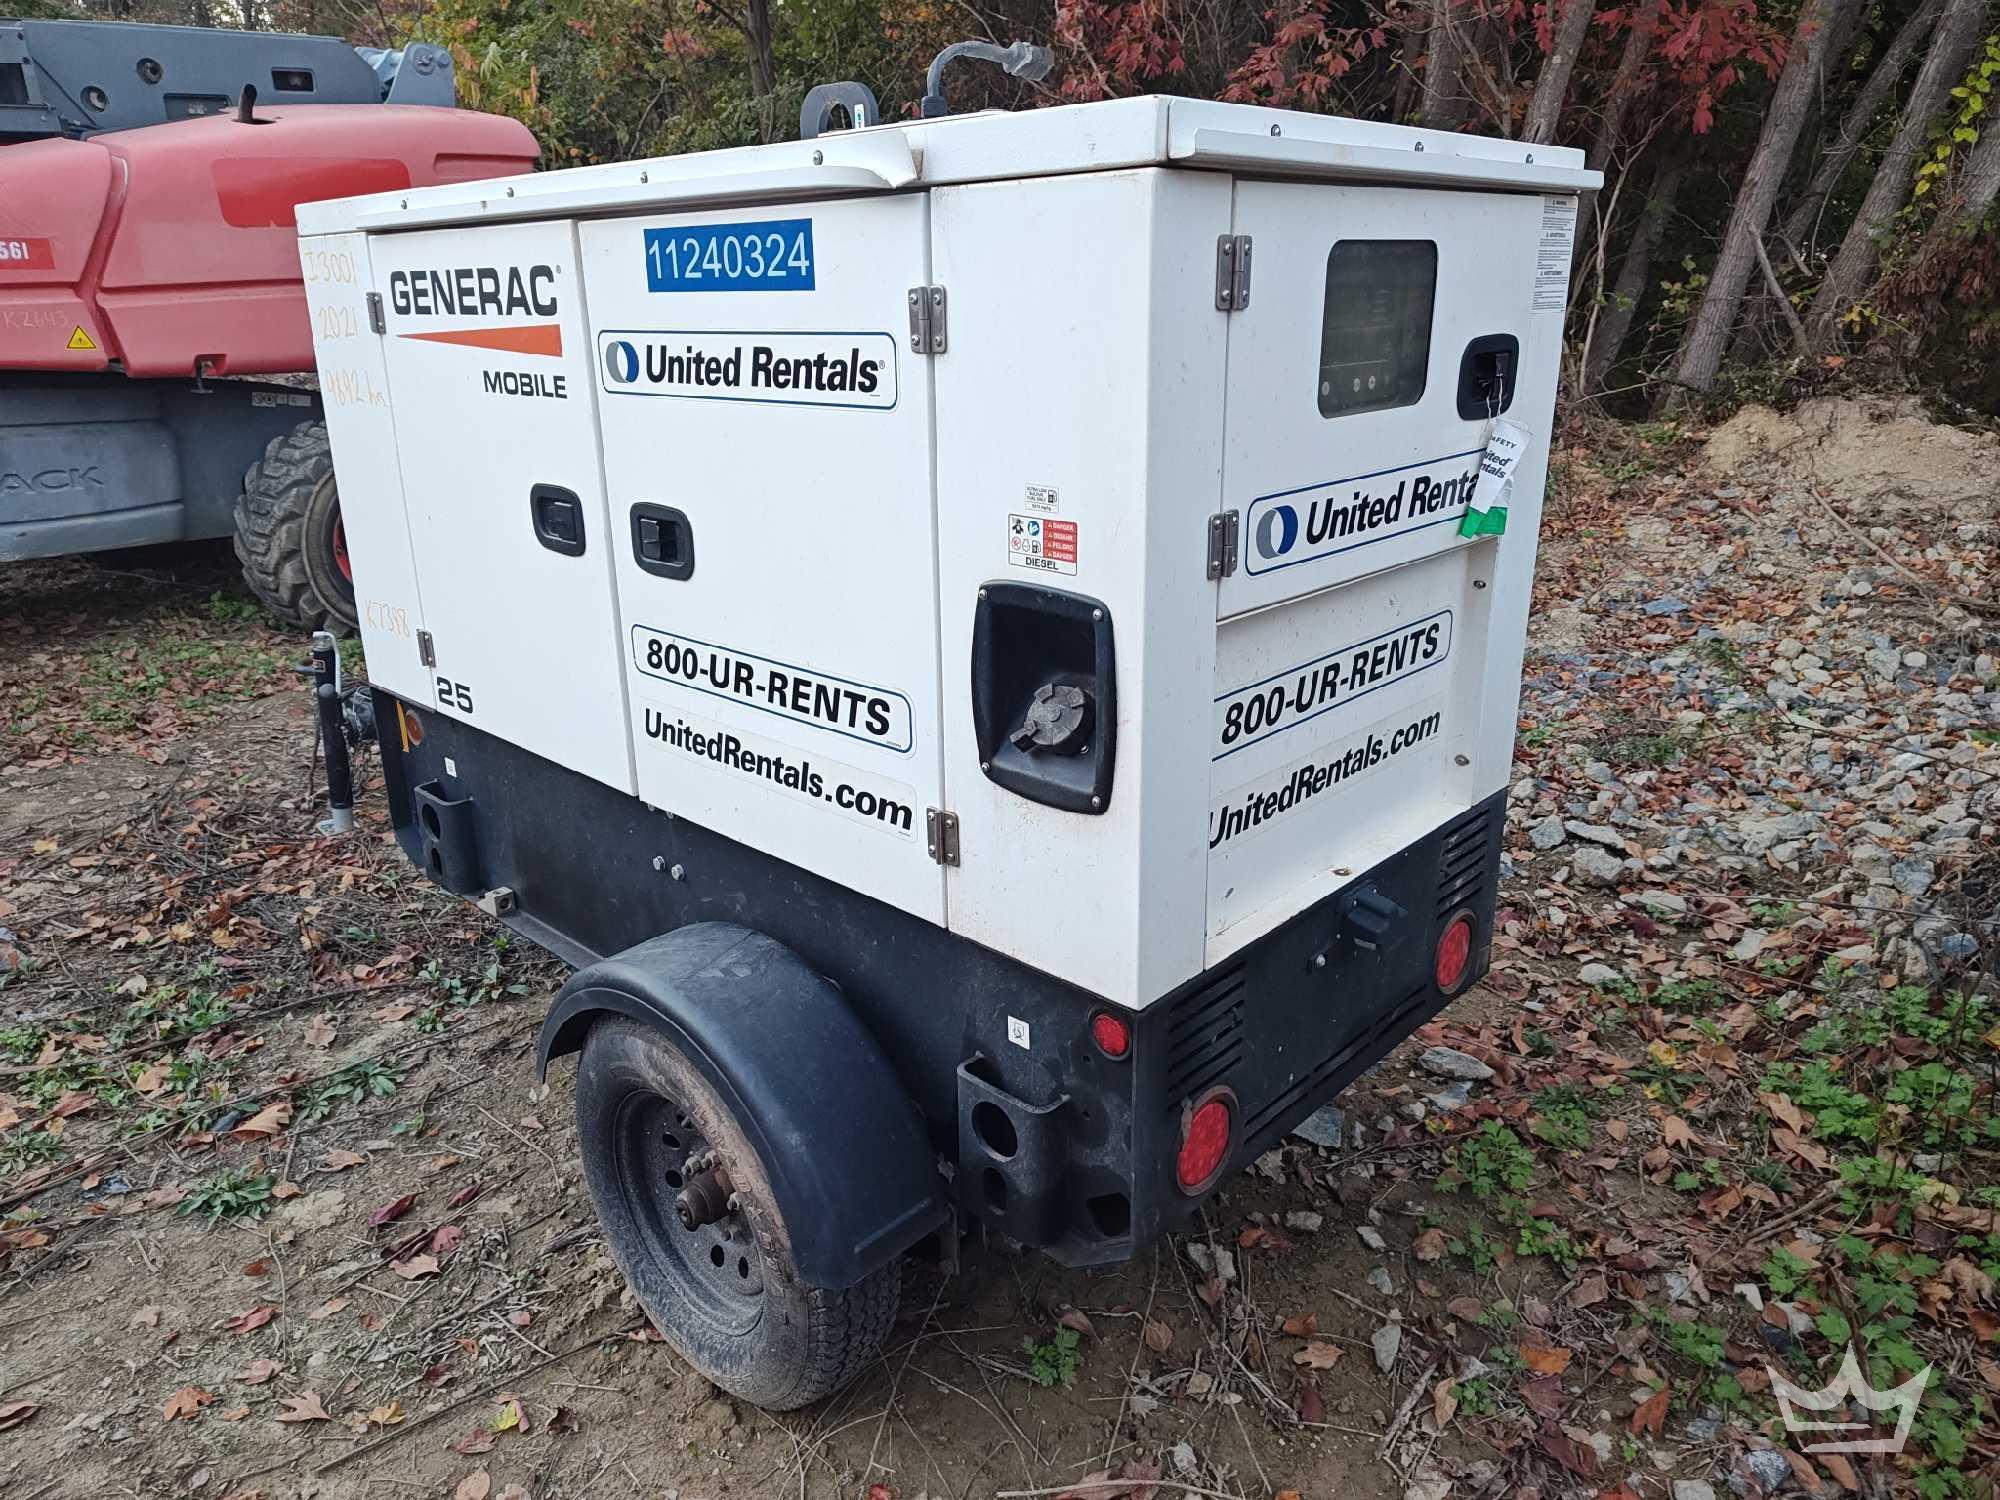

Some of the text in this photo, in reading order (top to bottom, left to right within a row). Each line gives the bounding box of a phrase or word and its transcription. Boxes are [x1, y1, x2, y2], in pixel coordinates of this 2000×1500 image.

[648, 231, 810, 280] 11240324
[389, 264, 558, 317] GENERAC
[318, 305, 359, 341] 2021
[482, 370, 568, 399] MOBILE
[646, 344, 880, 393] United Rentals
[1485, 450, 1510, 467] ited
[1492, 436, 1517, 449] AFETY
[0, 466, 104, 491] ACK
[1480, 463, 1506, 479] ntals
[1306, 470, 1480, 545] United Renta
[1025, 556, 1059, 570] DIESEL
[436, 676, 474, 714] 25
[646, 638, 891, 736] 800-UR-RENTS
[1221, 621, 1440, 745] 800-UR-RENTS
[644, 707, 914, 831] UnitedRentals.com
[1209, 712, 1441, 850] UnitedRentals.com
